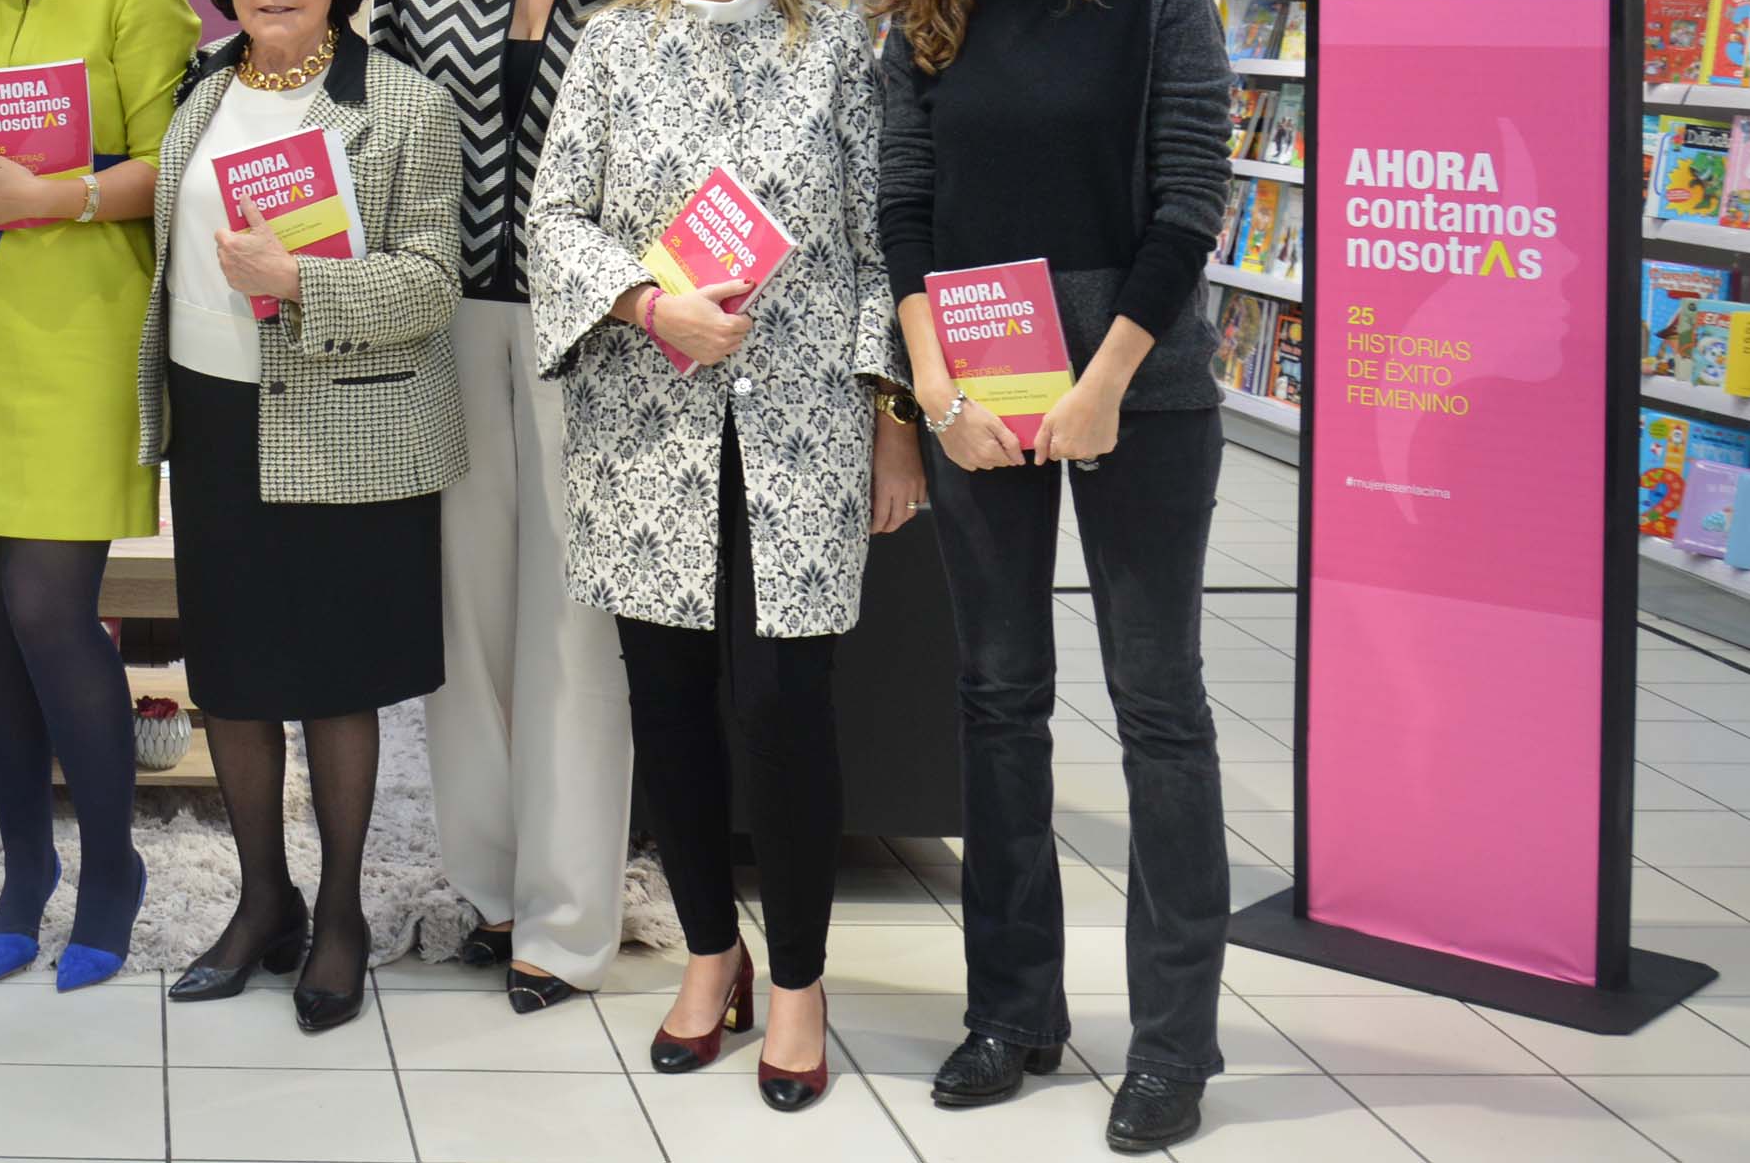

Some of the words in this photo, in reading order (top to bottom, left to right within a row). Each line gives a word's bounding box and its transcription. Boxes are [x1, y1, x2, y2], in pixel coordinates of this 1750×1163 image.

[228, 153, 289, 184] AHORA
[232, 165, 315, 200] contamos
[1345, 148, 1499, 193] AHORA
[706, 184, 754, 239] AHORA
[1346, 193, 1557, 238] contamos
[696, 200, 756, 267] contamos
[939, 282, 1006, 307] AHORA
[942, 300, 1035, 325] contamos
[1347, 306, 1375, 325] 25
[1347, 331, 1472, 362] HISTORIAS
[954, 359, 968, 369] 25
[1347, 358, 1379, 380] DE
[1385, 357, 1453, 387] ÉXITO
[1347, 385, 1469, 416] FEMENINO
